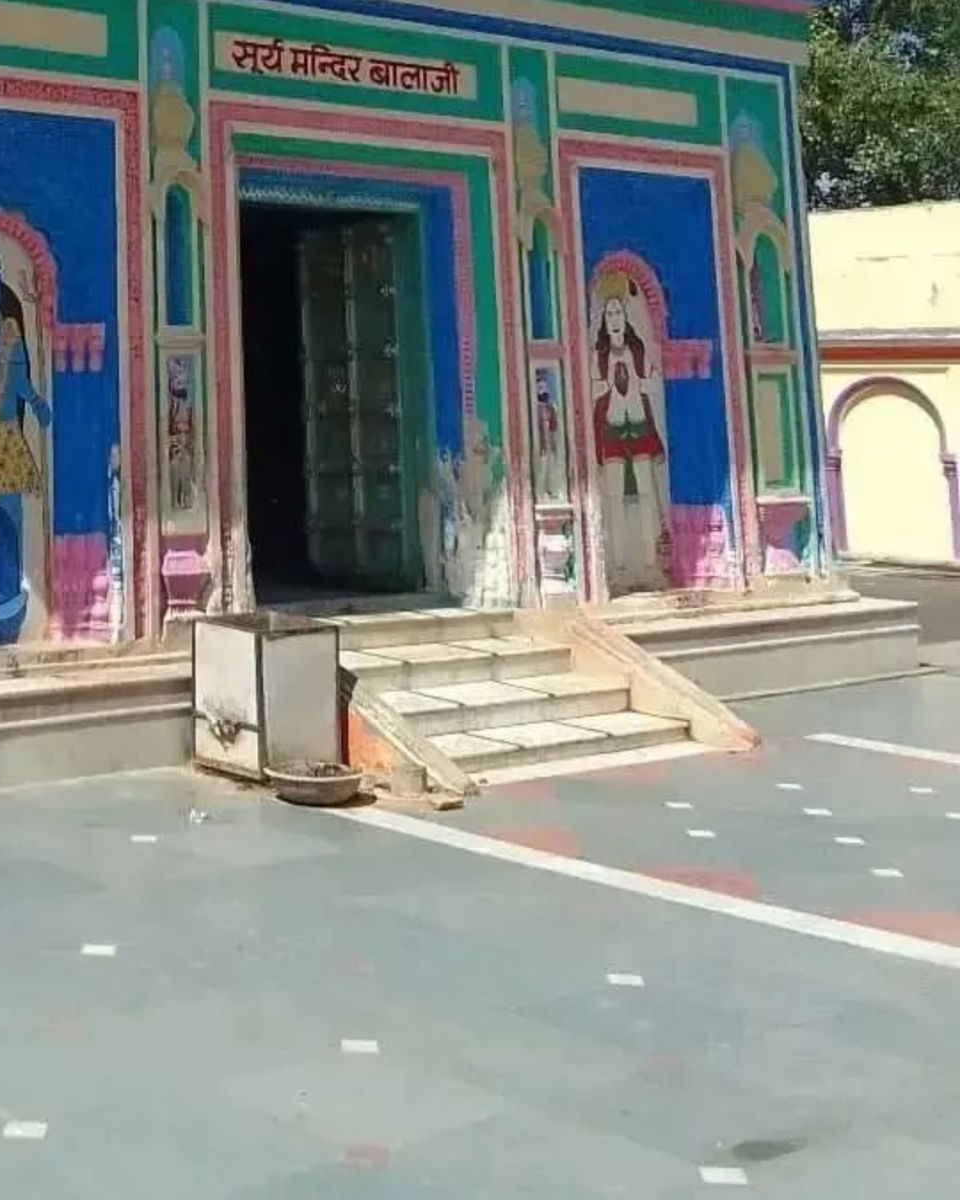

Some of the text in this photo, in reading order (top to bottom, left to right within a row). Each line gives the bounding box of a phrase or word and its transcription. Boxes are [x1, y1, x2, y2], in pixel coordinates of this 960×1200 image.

[232, 38, 459, 94] सूर्य मन्दिर बालाजी
